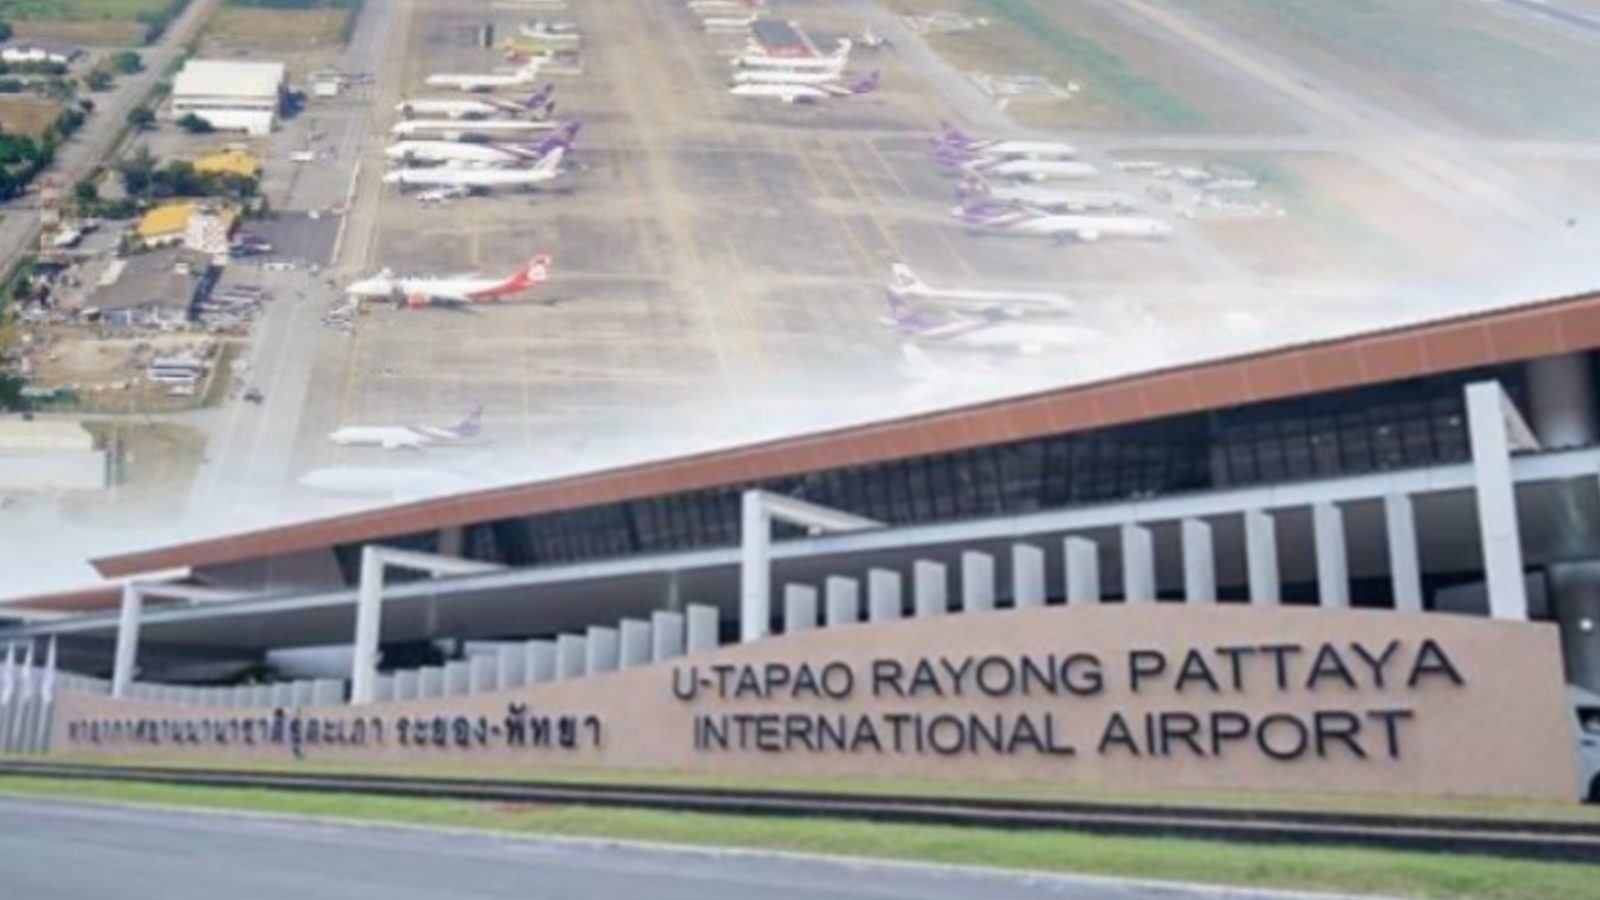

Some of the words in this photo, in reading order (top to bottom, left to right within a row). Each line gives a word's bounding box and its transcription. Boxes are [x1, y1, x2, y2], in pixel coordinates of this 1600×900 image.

[672, 661, 853, 701] U-TAPAO
[872, 653, 1103, 697] RAYONG
[1129, 638, 1464, 693] PATTAYA
[693, 713, 1077, 756] INTERNATIONAL
[1097, 709, 1414, 761] AIRPORT
